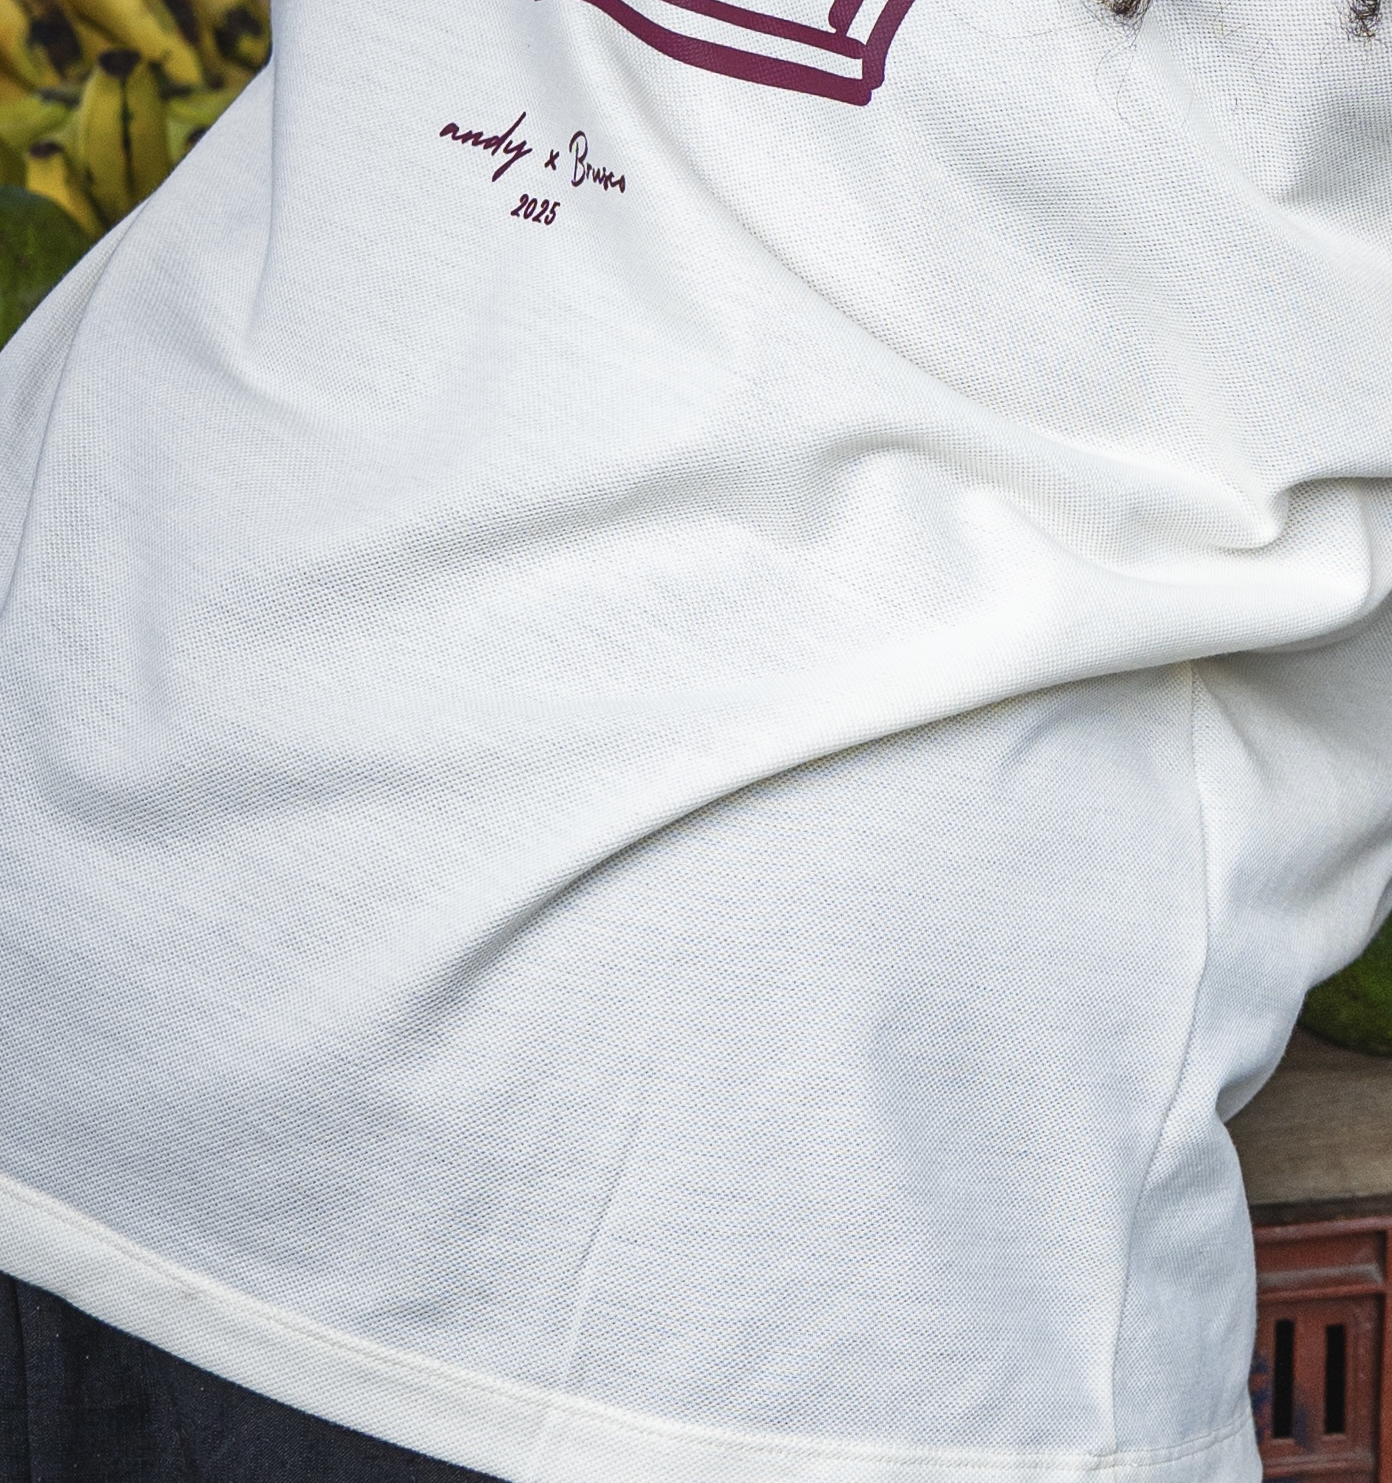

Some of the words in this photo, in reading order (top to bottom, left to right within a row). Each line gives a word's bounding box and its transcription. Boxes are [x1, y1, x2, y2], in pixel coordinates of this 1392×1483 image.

[439, 111, 533, 183] andy
[544, 149, 560, 171] x
[510, 193, 561, 226] 2025
